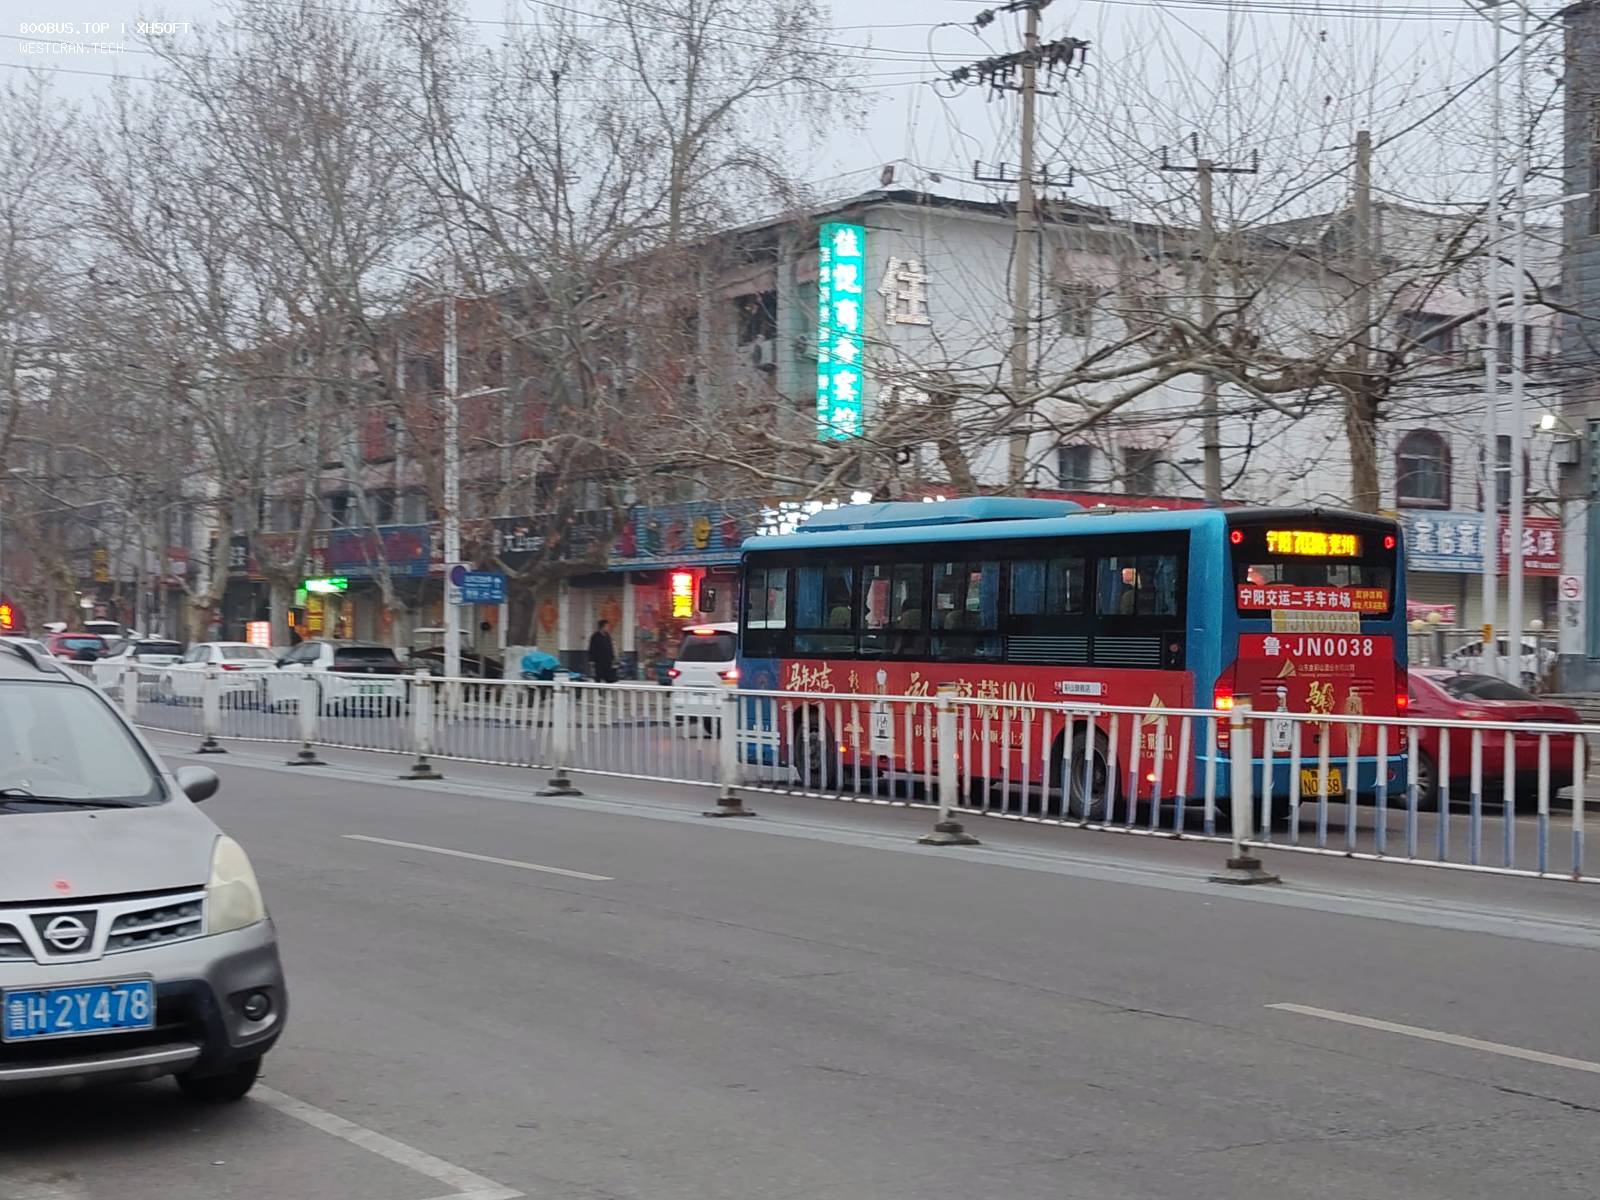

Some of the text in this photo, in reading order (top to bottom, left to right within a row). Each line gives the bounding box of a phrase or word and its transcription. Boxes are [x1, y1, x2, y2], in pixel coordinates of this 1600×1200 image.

[1240, 588, 1351, 608] 宁阳交运二手车市场
[1263, 636, 1373, 657] 鲁·JN0038
[1303, 778, 1341, 794] N038
